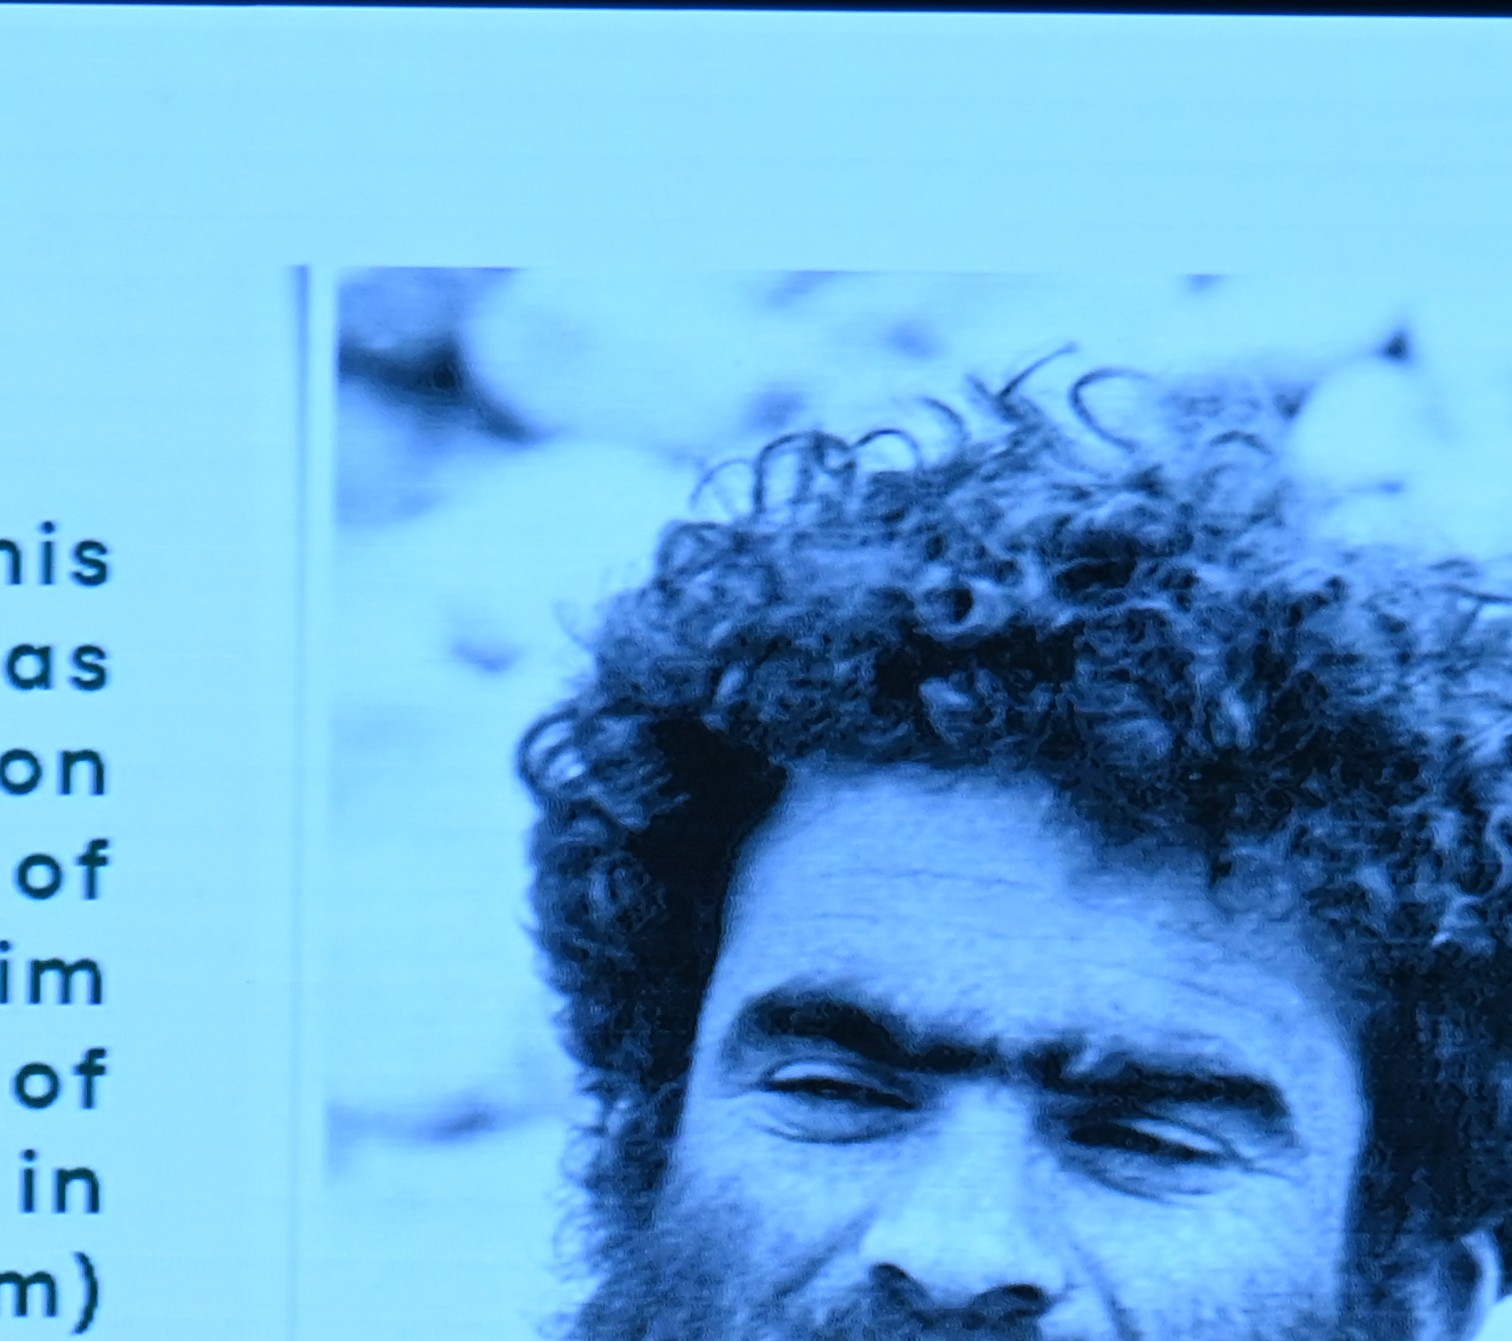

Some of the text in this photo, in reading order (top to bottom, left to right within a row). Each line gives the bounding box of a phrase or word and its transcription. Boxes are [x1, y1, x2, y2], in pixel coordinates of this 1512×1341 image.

[11, 835, 112, 904] of
[9, 1044, 110, 1113] of
[18, 1146, 103, 1217] in
